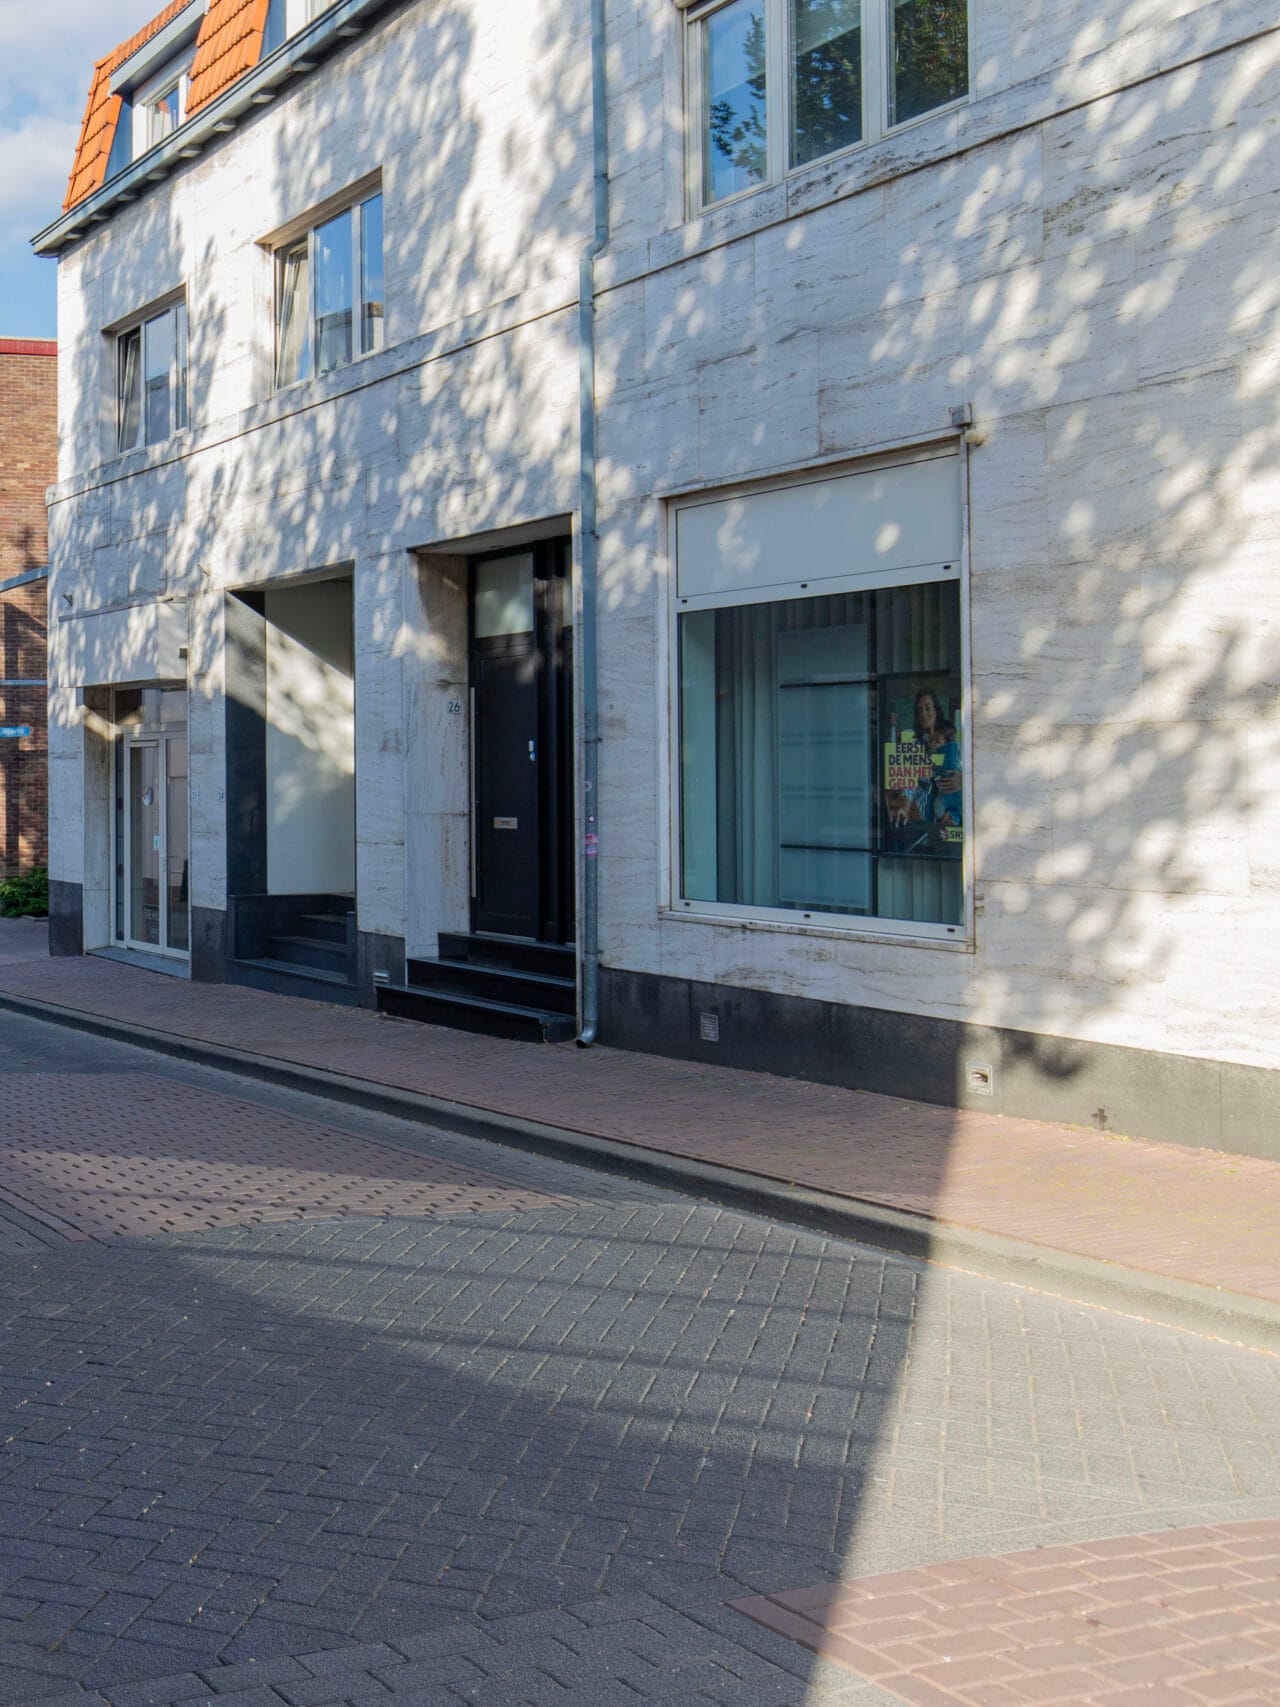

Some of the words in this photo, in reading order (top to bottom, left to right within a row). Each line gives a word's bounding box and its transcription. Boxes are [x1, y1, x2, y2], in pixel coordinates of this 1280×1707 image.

[448, 701, 461, 712] 26
[896, 742, 925, 753] EERST
[889, 754, 901, 765] DE
[889, 767, 912, 777] DAN
[914, 767, 933, 777] HET
